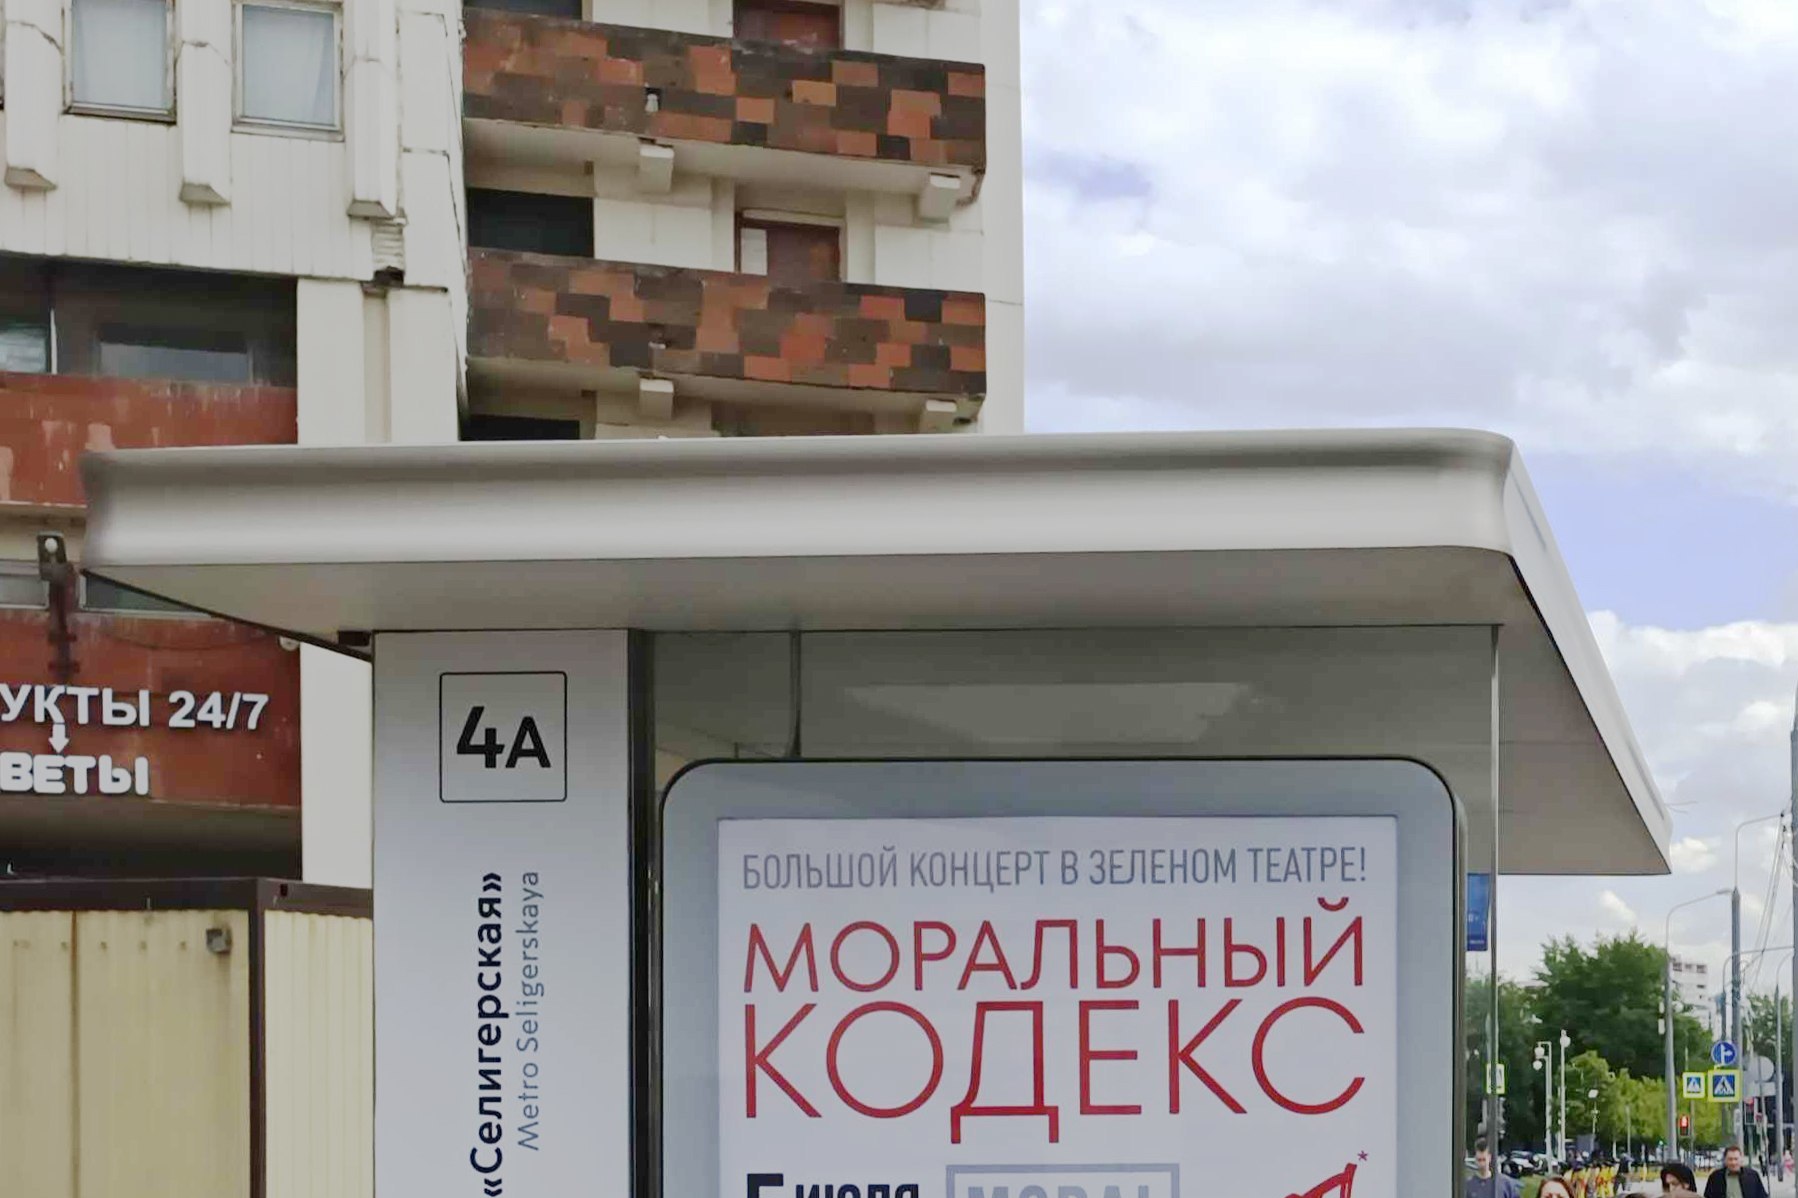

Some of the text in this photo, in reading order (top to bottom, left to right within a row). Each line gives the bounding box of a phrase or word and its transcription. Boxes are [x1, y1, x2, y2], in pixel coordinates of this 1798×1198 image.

[168, 690, 269, 730] 24/7
[743, 845, 1366, 893] БОЛЬШОЙ КОНЦЕРТ В ЗЕЛЕНОМ ТЕАТРЕ!
[744, 897, 1364, 992] МОРАЛЬНЫЙ
[470, 872, 509, 1197] «Селигерская»
[515, 871, 544, 1151] Metro Seligerskaya
[745, 997, 1365, 1144] КОДЕКС
